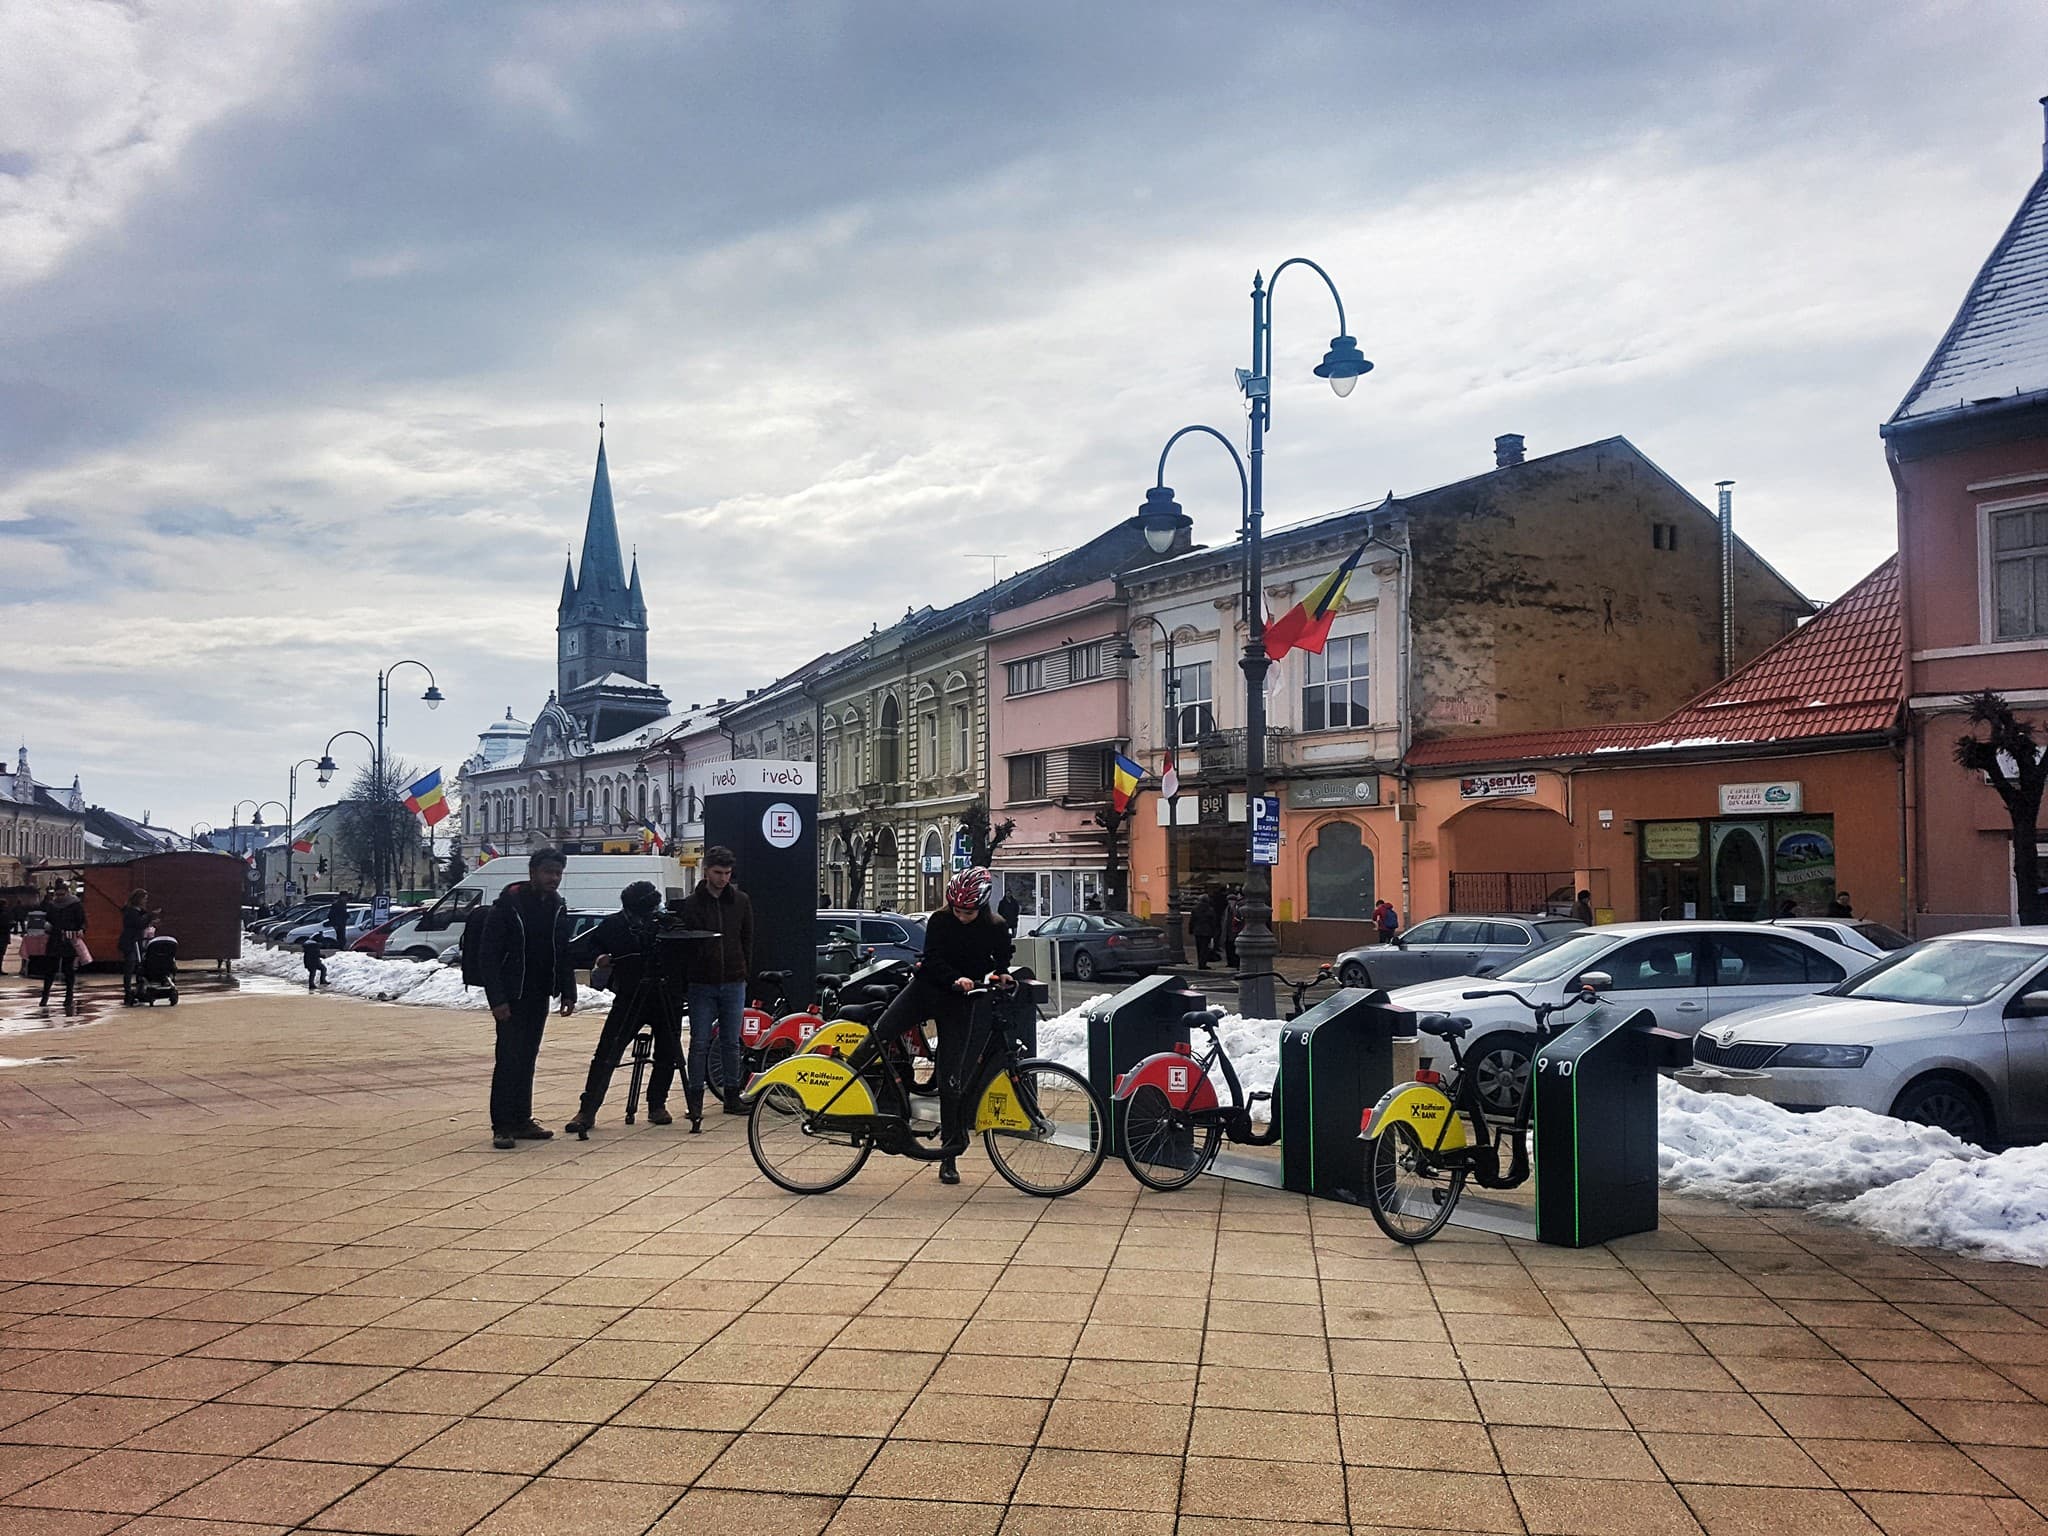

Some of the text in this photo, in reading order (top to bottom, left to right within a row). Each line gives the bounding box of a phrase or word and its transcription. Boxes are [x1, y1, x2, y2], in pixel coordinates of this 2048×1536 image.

[1489, 773, 1536, 787] service
[1201, 794, 1223, 813] gigi
[1253, 797, 1267, 832] P
[379, 899, 387, 908] P
[1090, 1012, 1111, 1023] 5 6
[1284, 1030, 1309, 1045] 7 8
[1537, 1058, 1573, 1076] 9 10
[810, 1071, 844, 1081] Raiffeisen
[1421, 1111, 1437, 1119] BANK
